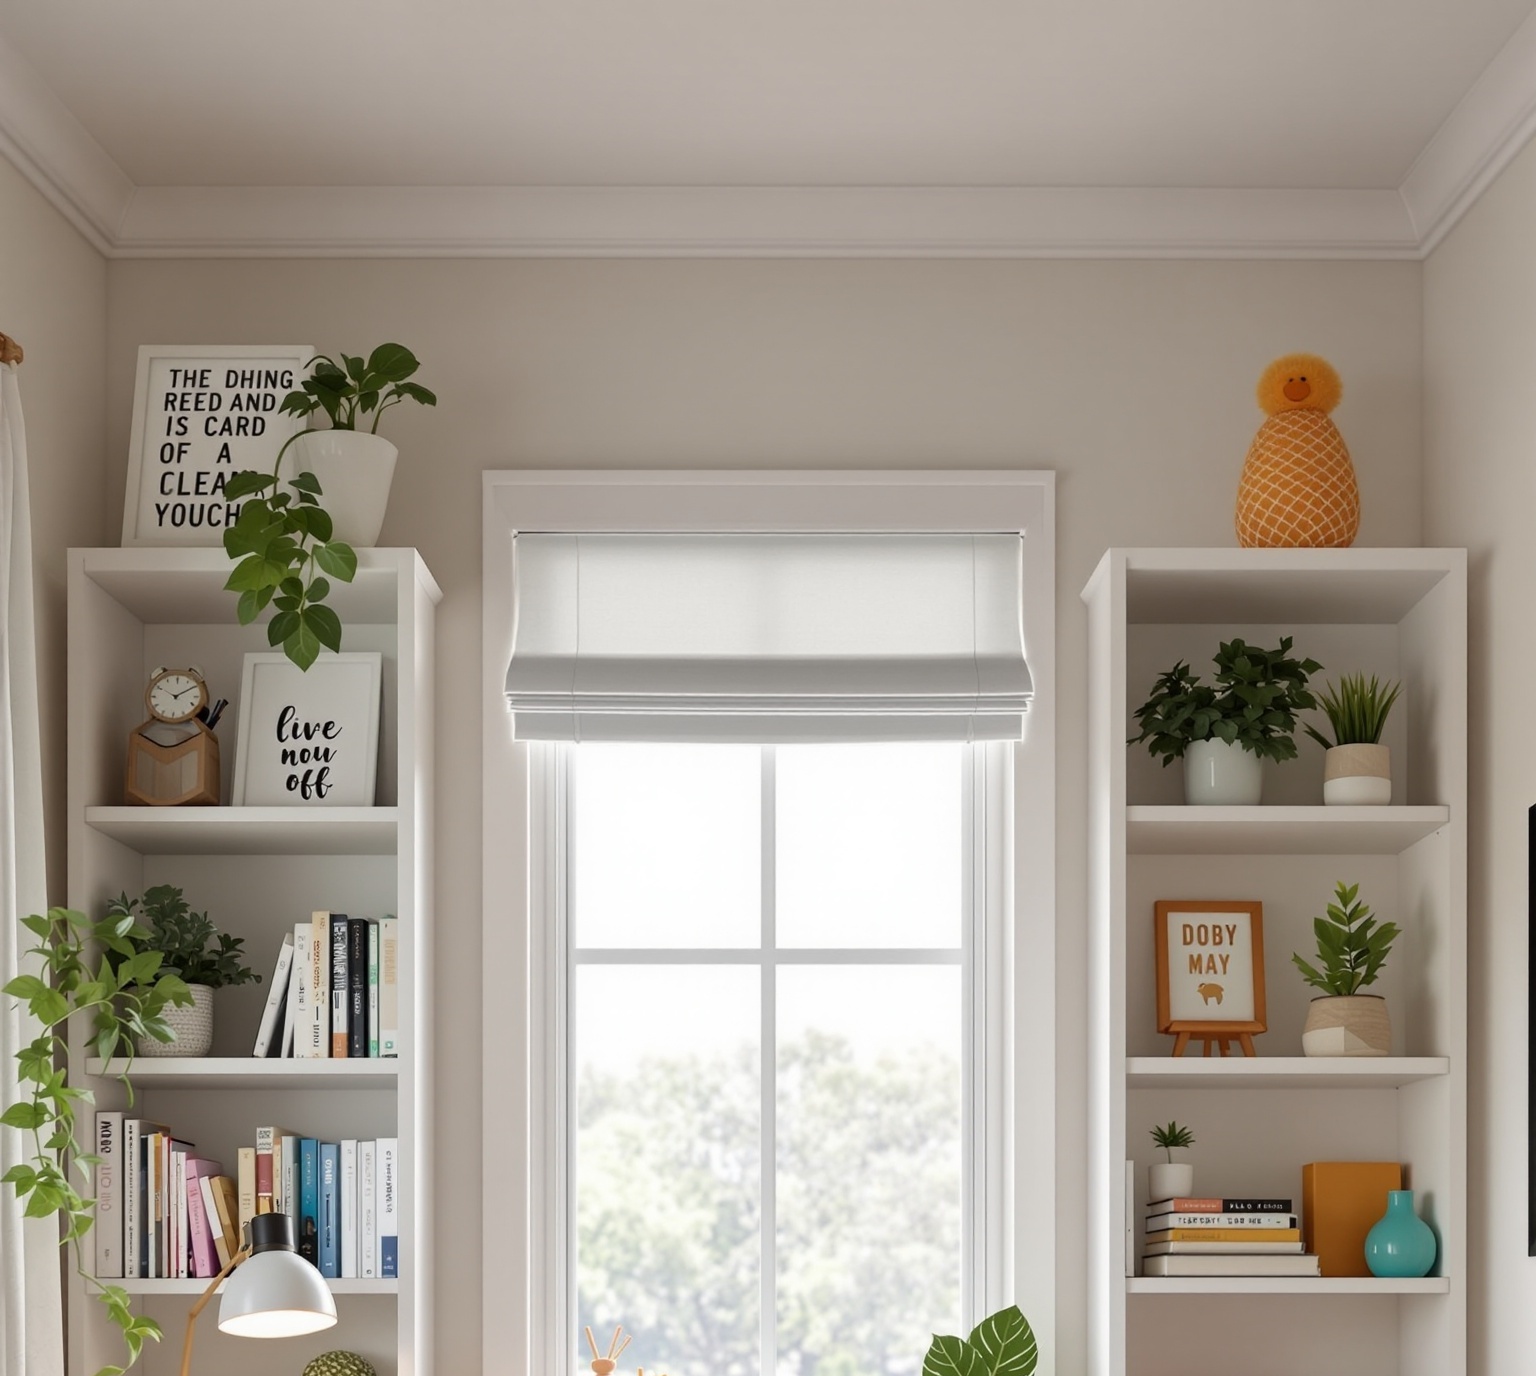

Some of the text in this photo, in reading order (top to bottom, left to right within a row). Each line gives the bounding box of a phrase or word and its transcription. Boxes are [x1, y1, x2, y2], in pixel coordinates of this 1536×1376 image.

[169, 369, 293, 389] THE DHING
[163, 393, 275, 411] REED AND
[166, 416, 265, 436] IS CARD
[159, 443, 231, 464] OF A
[159, 471, 238, 496] CLEA
[155, 503, 240, 527] YOUCH
[277, 705, 342, 743] live
[286, 766, 333, 800] off
[1182, 924, 1237, 946] DOBY
[1188, 953, 1230, 975] MAY
